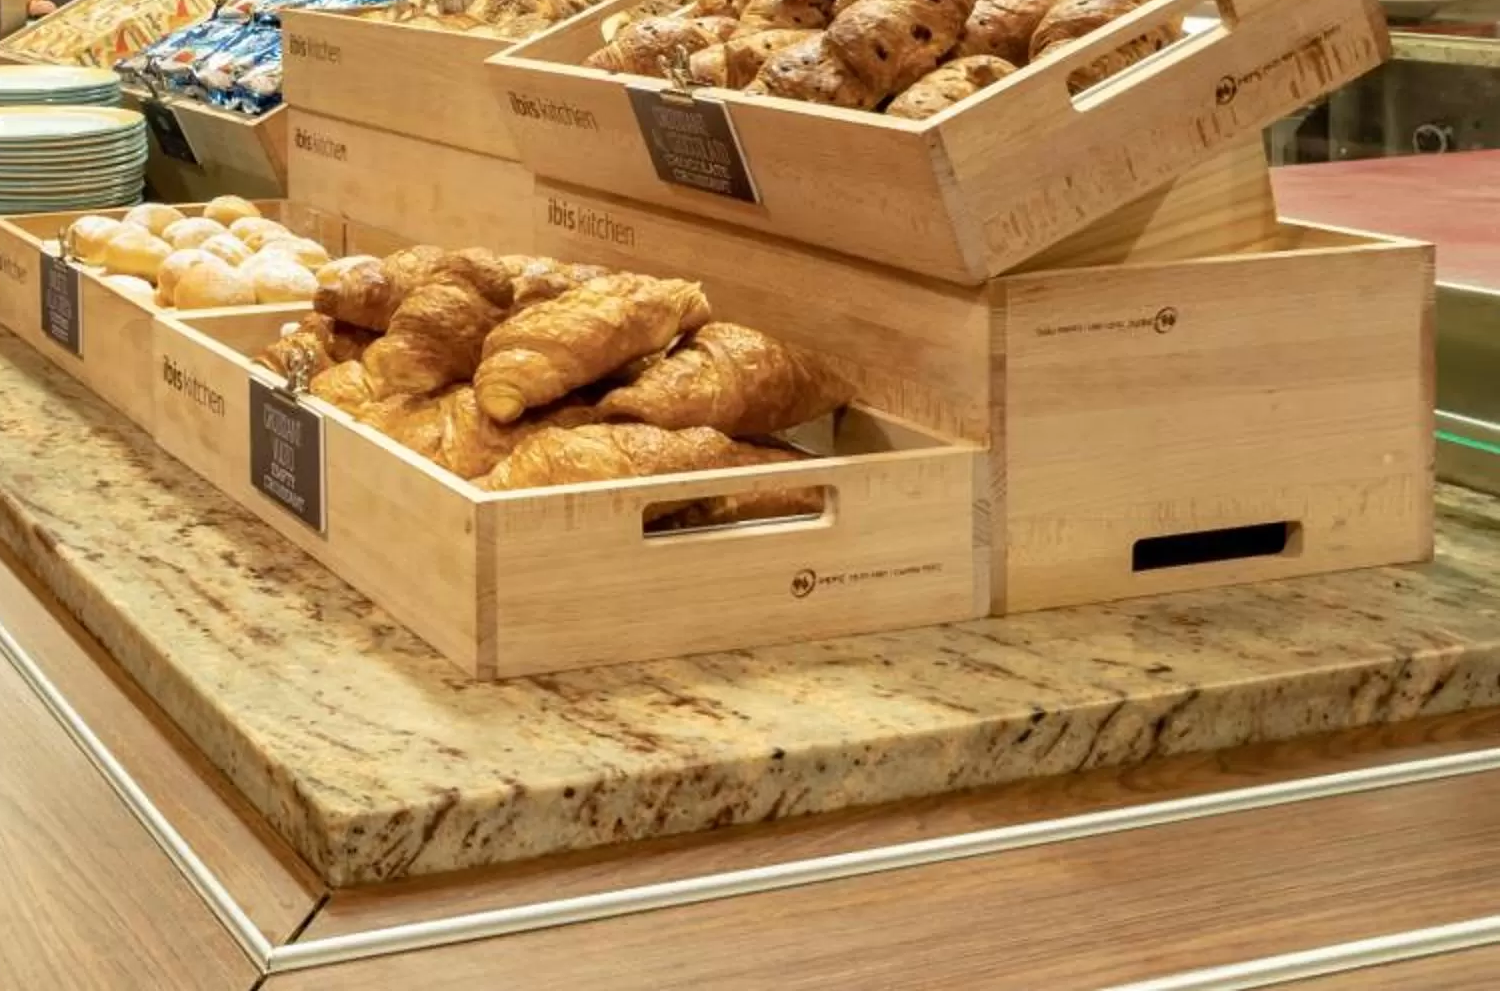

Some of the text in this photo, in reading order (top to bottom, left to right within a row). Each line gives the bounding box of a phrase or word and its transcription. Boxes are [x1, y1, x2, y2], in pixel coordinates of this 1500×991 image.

[508, 91, 598, 132] ibis kitchen
[548, 198, 635, 247] ibis kitchen
[164, 354, 225, 417] ibis kitchen
